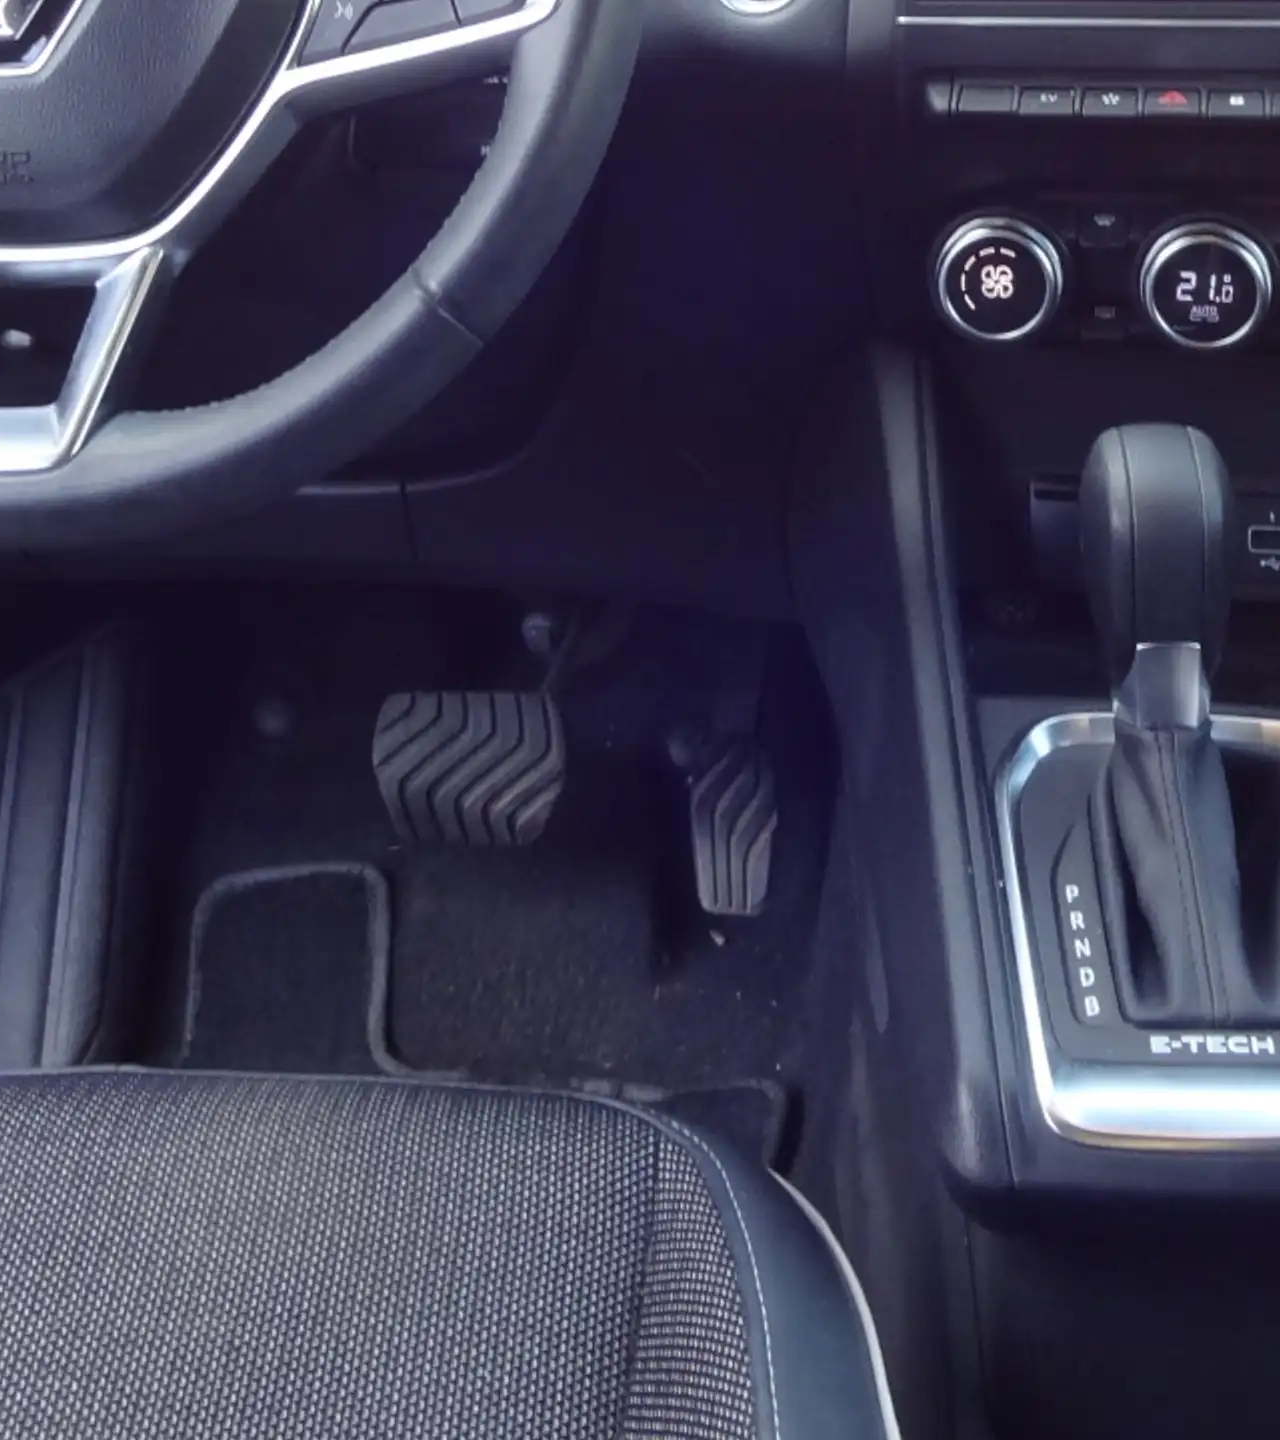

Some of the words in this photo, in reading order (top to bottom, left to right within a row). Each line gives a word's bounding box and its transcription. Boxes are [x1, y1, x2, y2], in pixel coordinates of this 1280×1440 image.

[1065, 883, 1080, 904] P
[1069, 910, 1085, 931] R
[1074, 937, 1092, 959] N
[1079, 966, 1095, 988] D
[1084, 995, 1101, 1017] B
[1149, 1034, 1276, 1056] E-TECH
